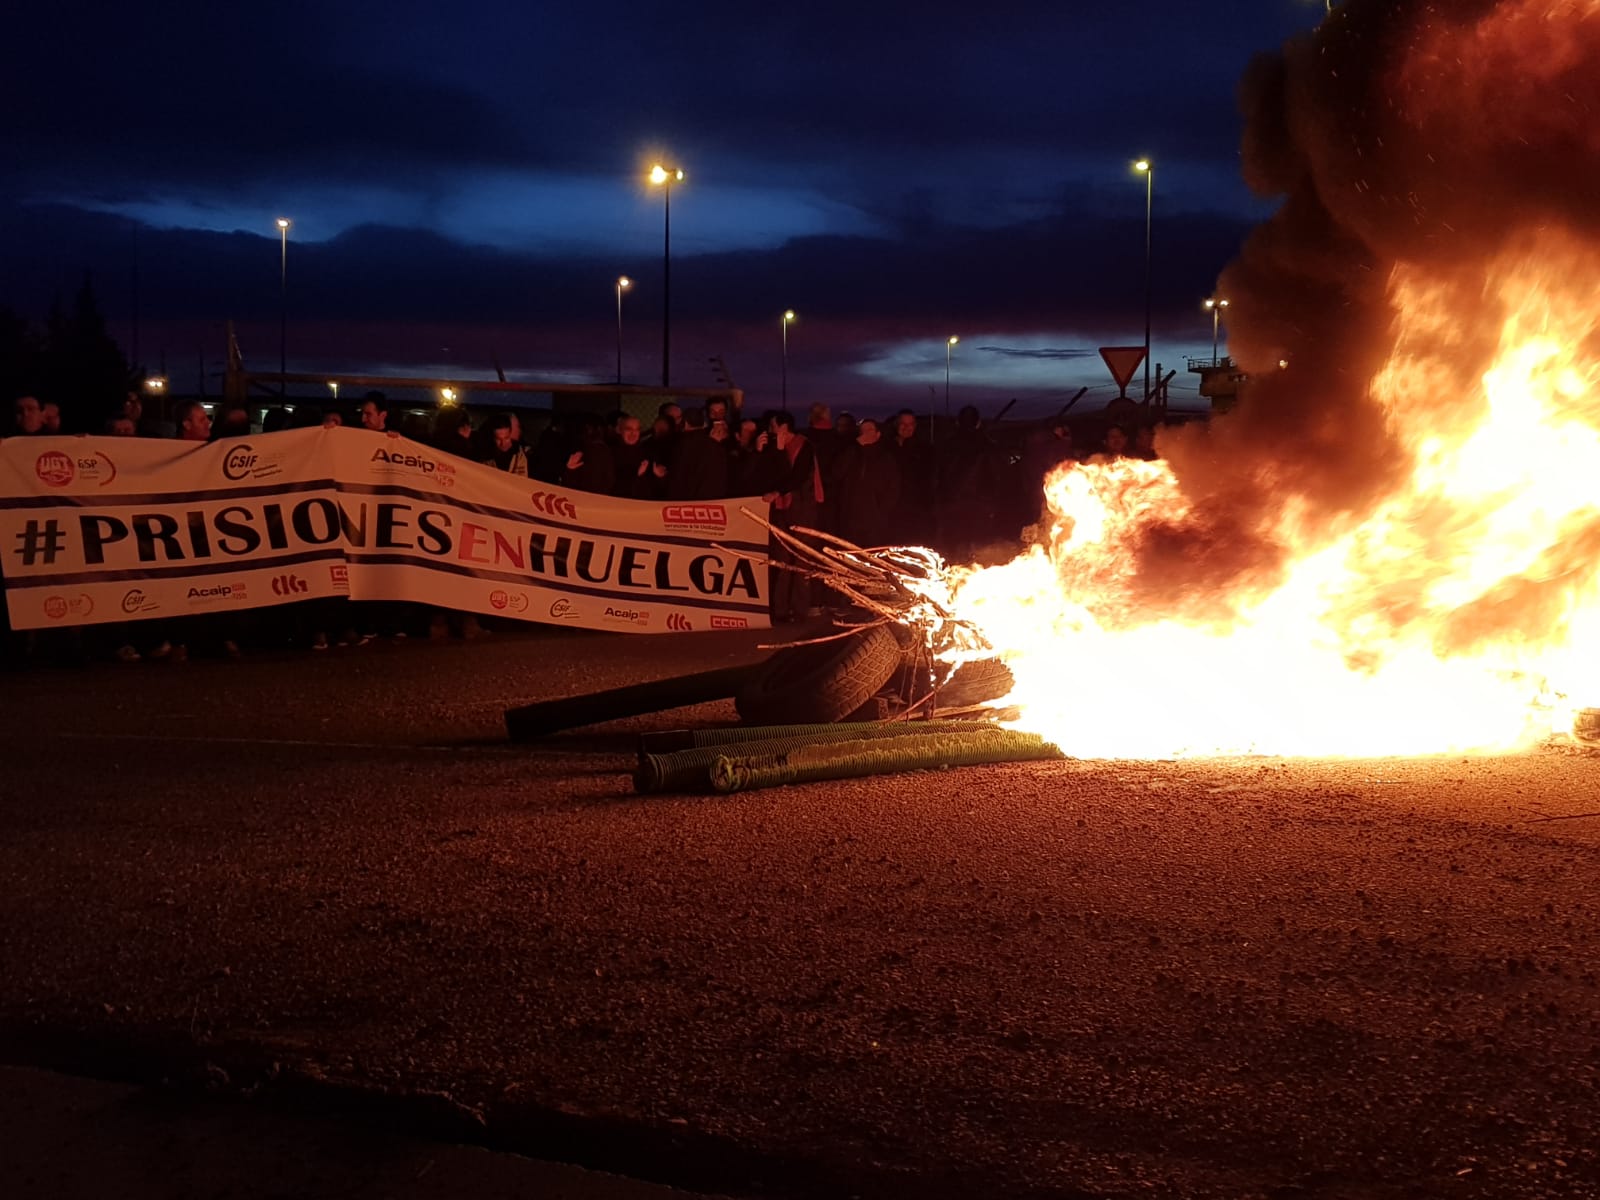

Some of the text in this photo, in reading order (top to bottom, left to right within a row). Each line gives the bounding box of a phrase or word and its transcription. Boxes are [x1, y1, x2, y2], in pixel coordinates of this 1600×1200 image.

[229, 455, 259, 469] CSIF
[371, 448, 435, 473] Acaip
[665, 507, 725, 521] CCOO
[187, 584, 232, 599] Acaip
[604, 607, 639, 621] Acaip
